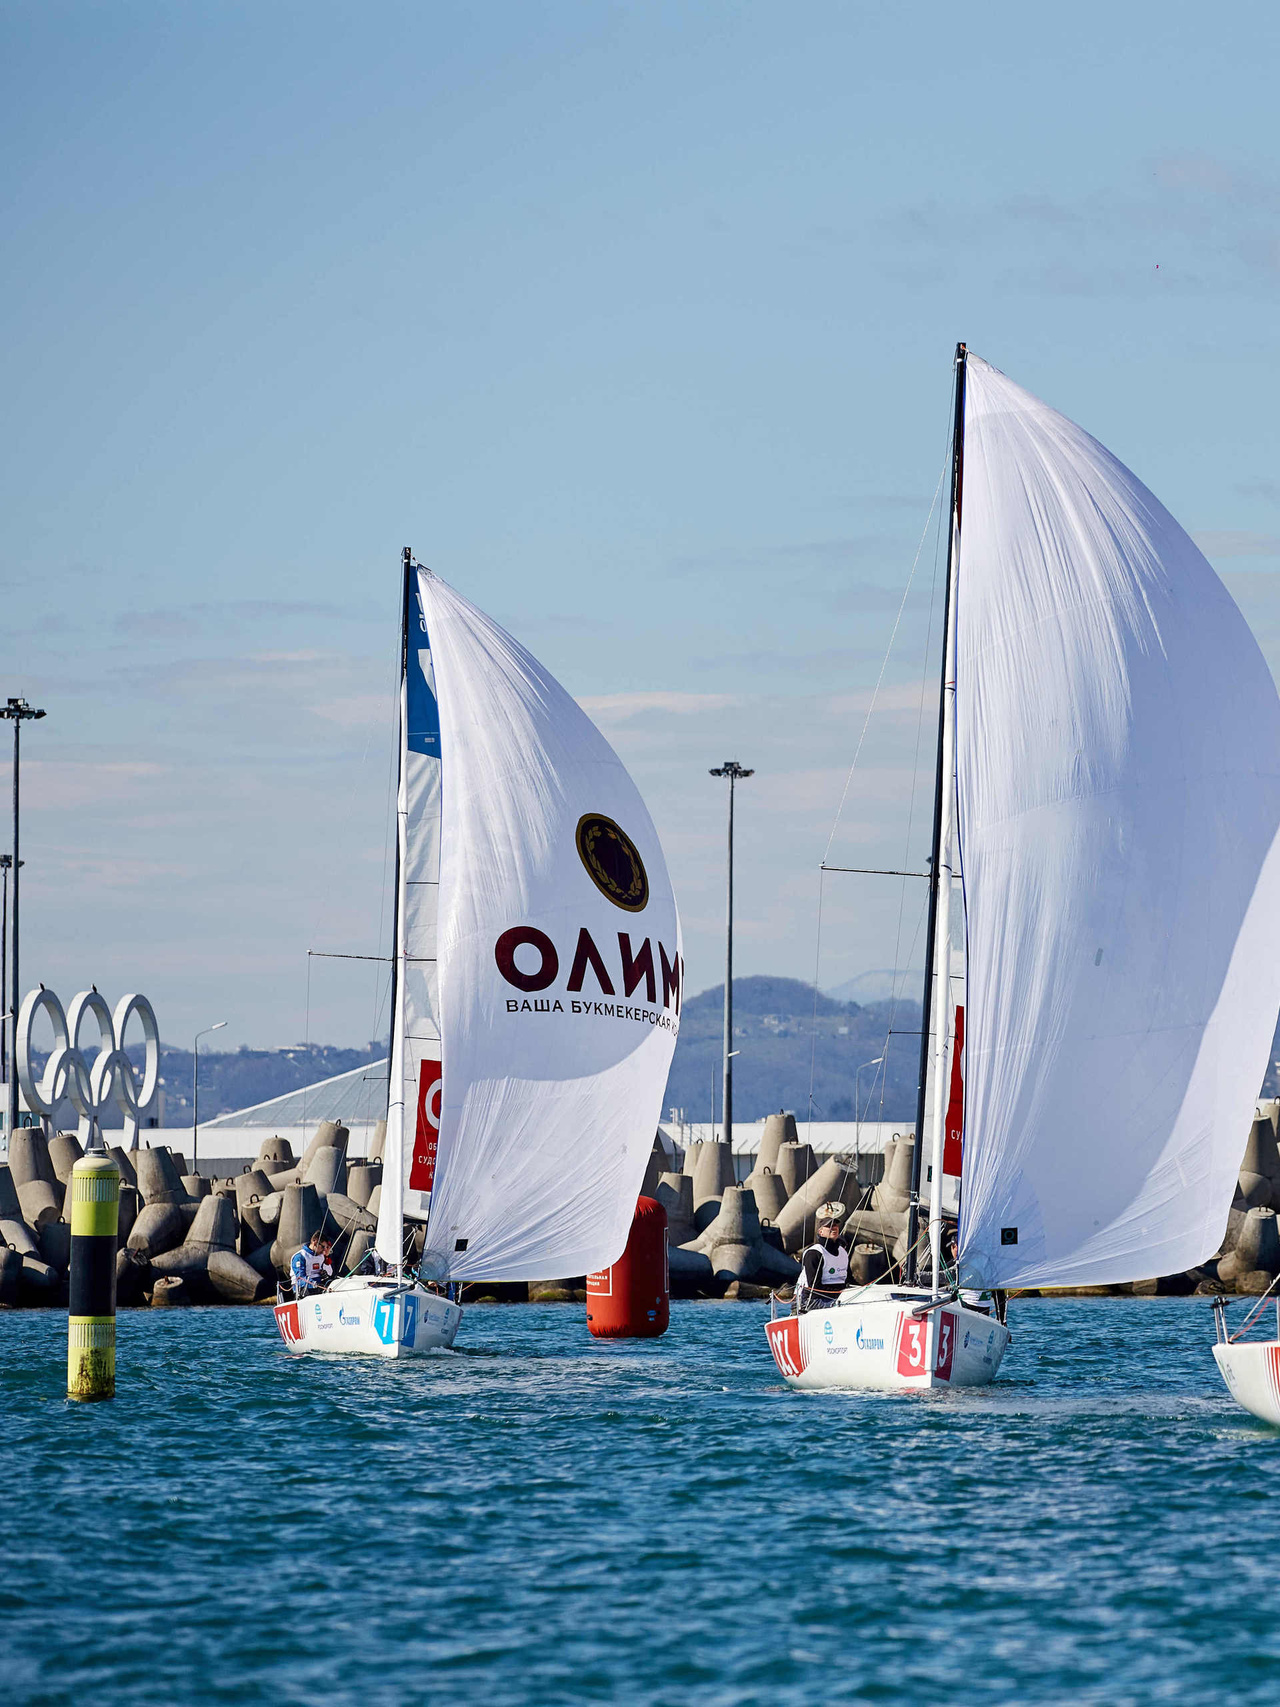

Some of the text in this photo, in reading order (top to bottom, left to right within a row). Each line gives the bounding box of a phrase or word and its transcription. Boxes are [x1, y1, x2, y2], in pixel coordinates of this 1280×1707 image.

[495, 926, 684, 1017] ОЛИМ
[506, 999, 564, 1013] ВАША
[571, 1001, 671, 1031] БУКМЕКЕРСКАЯ
[381, 1305, 391, 1338] 7
[405, 1305, 414, 1337] 7
[908, 1325, 921, 1367] 3
[938, 1325, 950, 1368] 3
